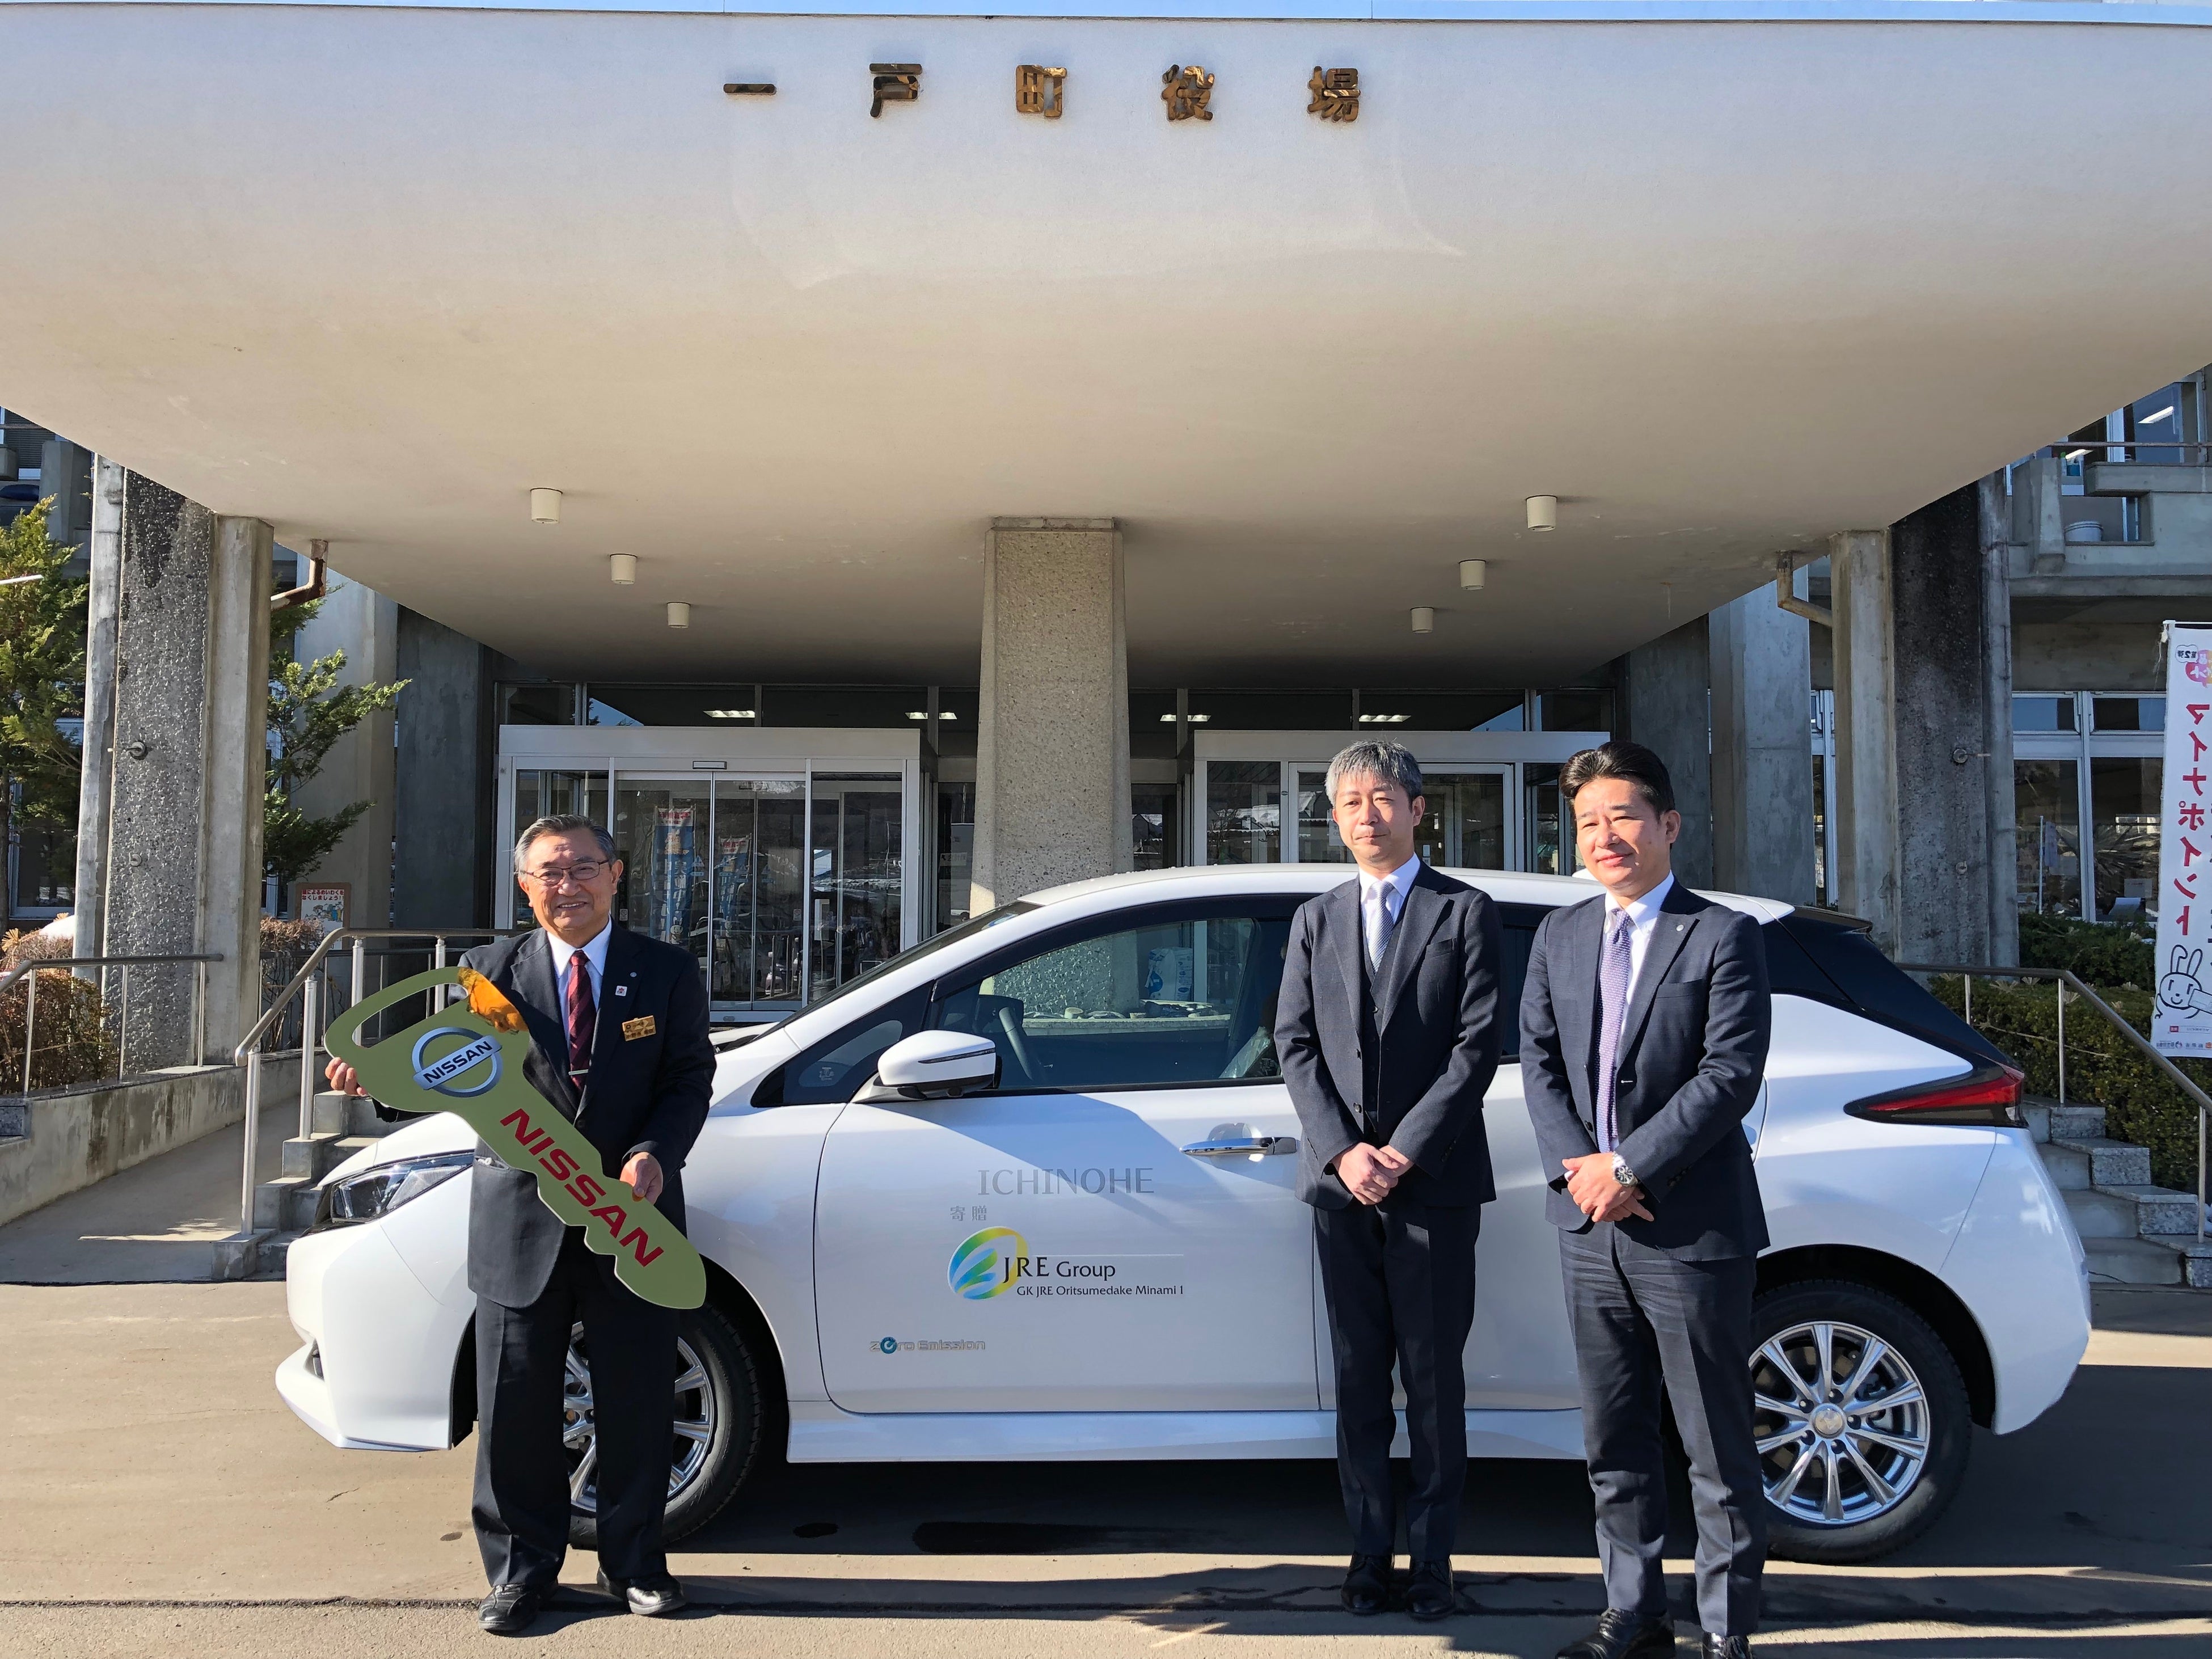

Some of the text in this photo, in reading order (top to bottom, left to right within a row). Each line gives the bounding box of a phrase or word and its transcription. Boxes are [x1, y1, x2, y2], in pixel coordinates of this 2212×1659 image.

[723, 62, 1361, 123] 一戸町役場
[423, 1040, 493, 1084] NISSAN
[500, 1108, 664, 1268] NISSAN
[977, 1167, 1155, 1196] ICHINOHE
[949, 1205, 988, 1222] 寄贈
[1002, 1256, 1116, 1284] JRE Group
[1016, 1286, 1034, 1295] GK
[1036, 1286, 1053, 1298] JRE
[1056, 1285, 1133, 1295] Oritsumedake
[1135, 1285, 1176, 1295] Minami
